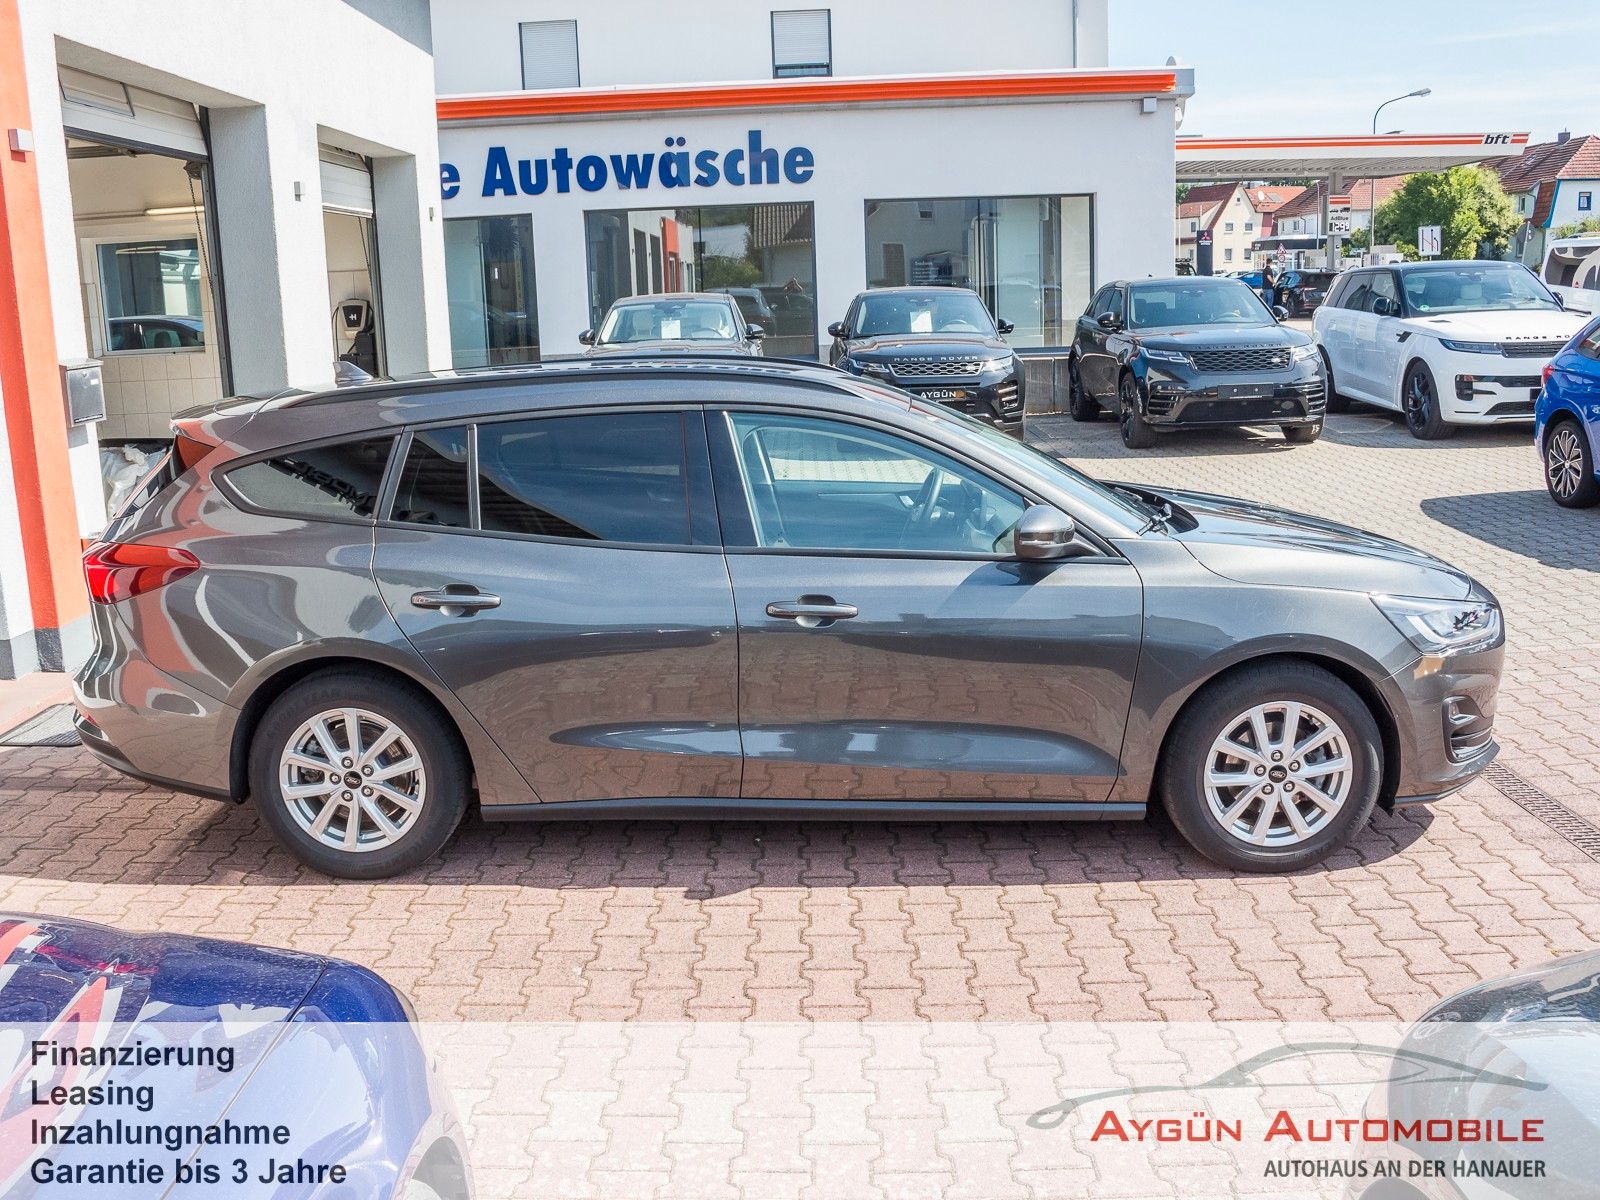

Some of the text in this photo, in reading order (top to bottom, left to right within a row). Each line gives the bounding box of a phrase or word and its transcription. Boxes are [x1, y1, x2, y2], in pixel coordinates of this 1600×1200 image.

[1484, 134, 1510, 145] bft
[440, 129, 815, 200] e Autowäsche
[920, 389, 957, 399] AYGÜN
